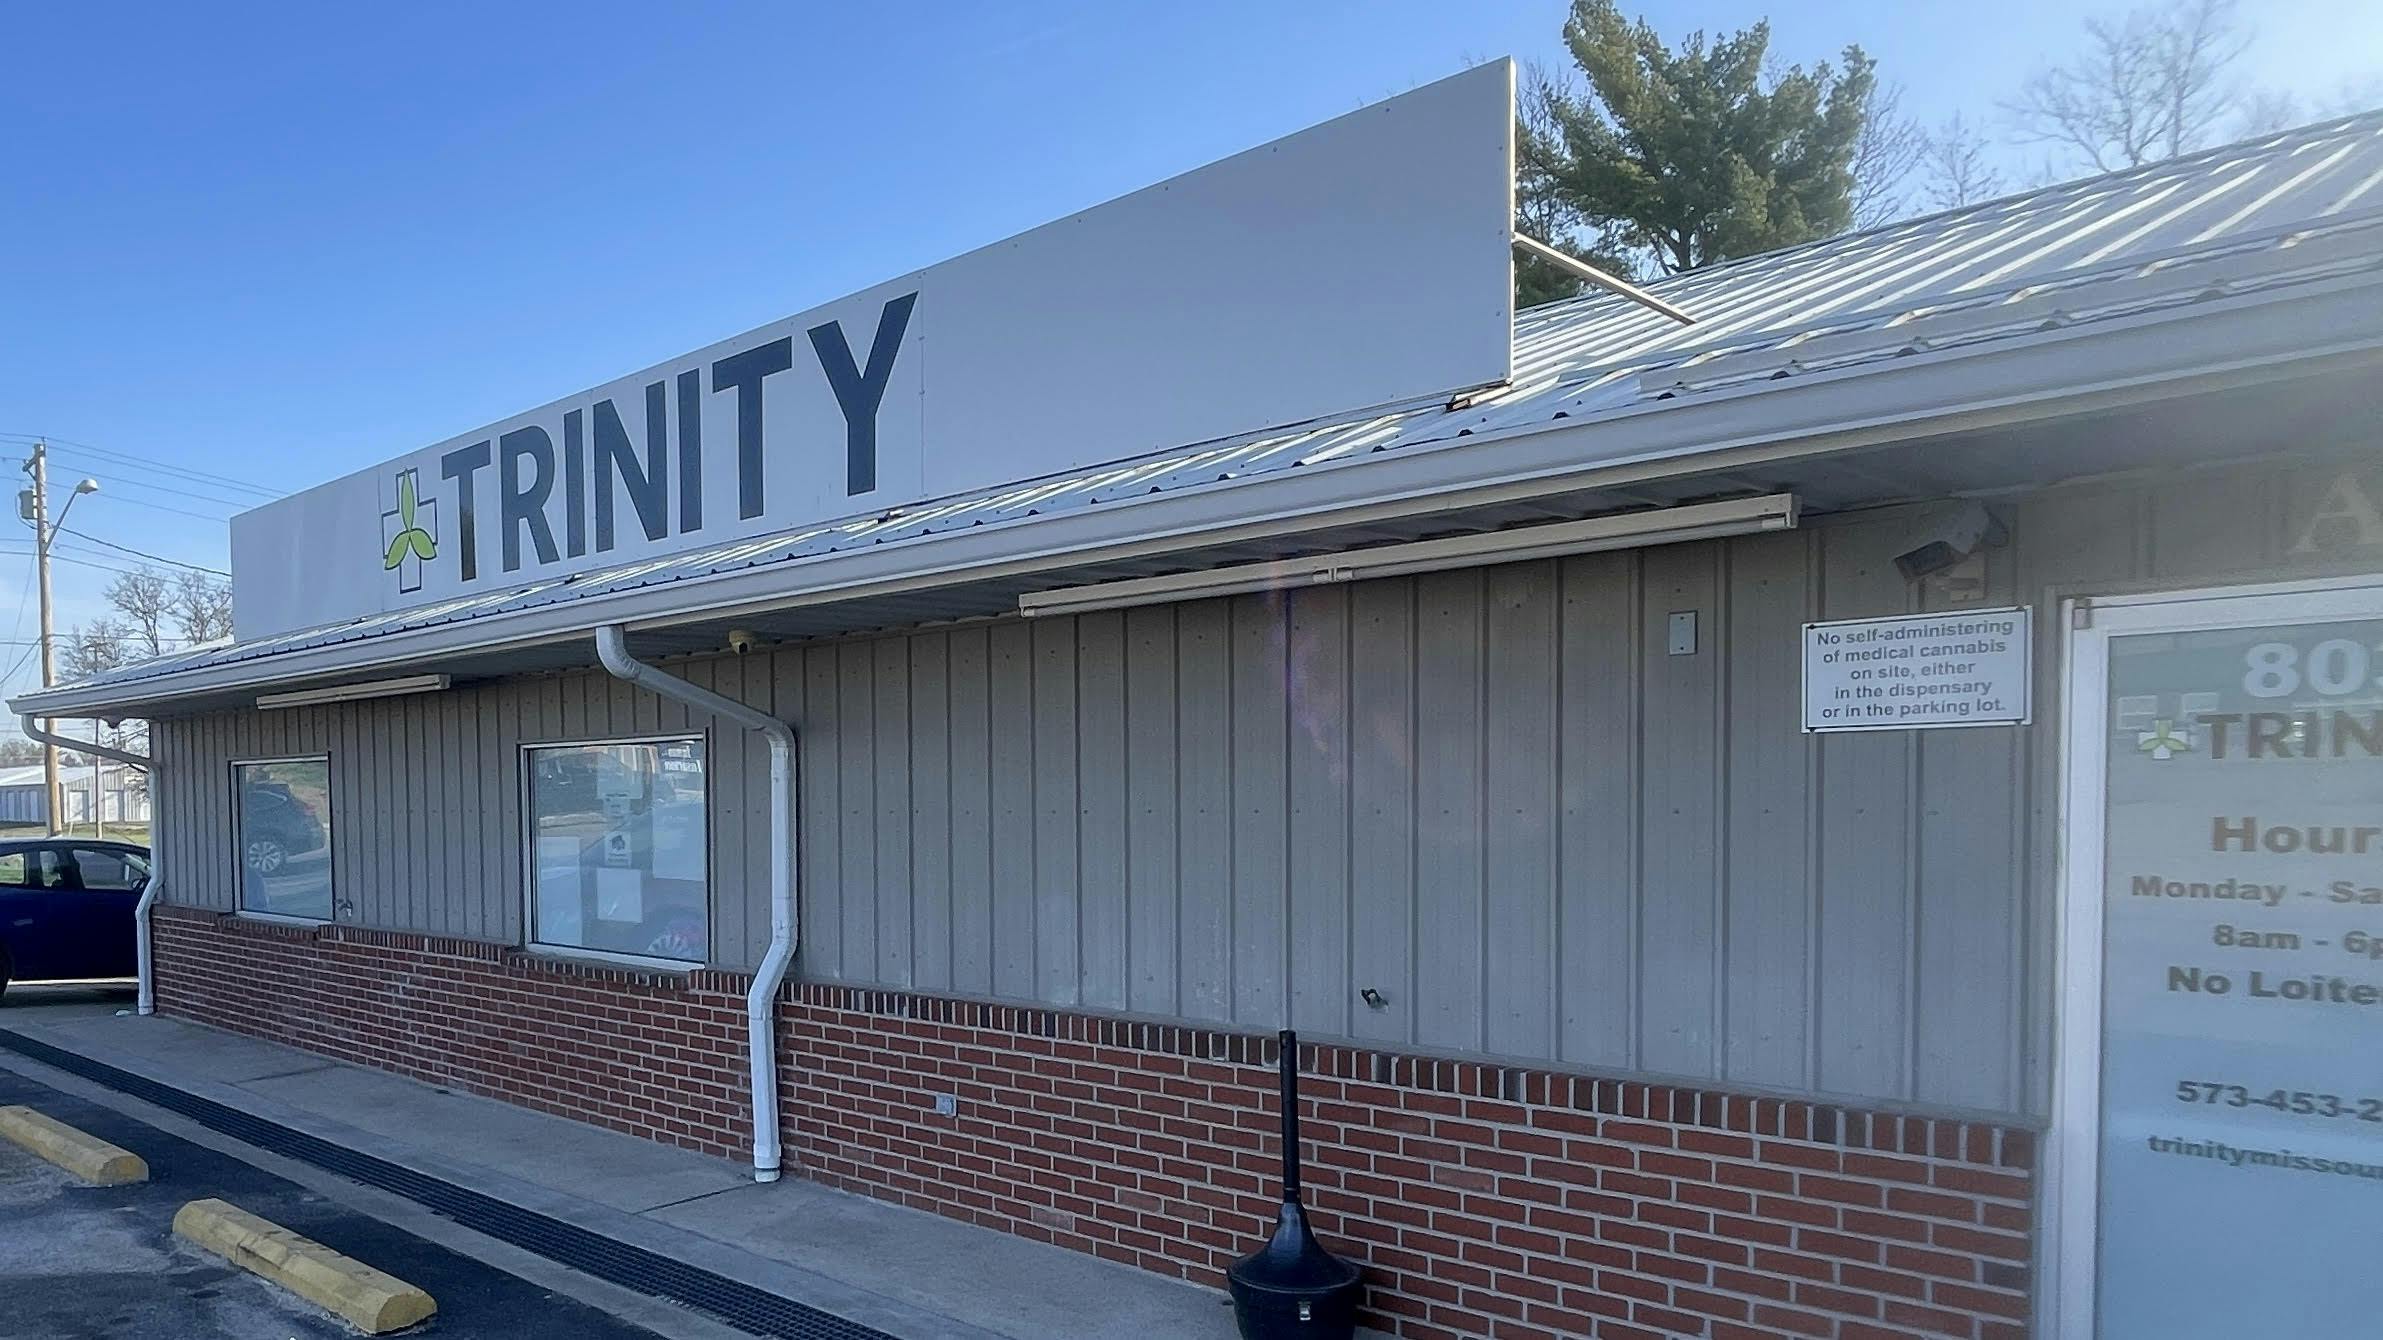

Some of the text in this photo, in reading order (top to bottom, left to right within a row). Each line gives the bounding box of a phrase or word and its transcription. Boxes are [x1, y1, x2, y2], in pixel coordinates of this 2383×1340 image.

[441, 291, 919, 582] TRINITY
[1817, 620, 2014, 646] No self-administering
[1823, 639, 2006, 663] of medical cannabis
[1851, 661, 1976, 680] on site, either
[2243, 639, 2383, 698] 80
[1835, 679, 1992, 699] in the dispensary
[1822, 697, 2006, 719] or in the parking lot.
[2195, 711, 2383, 759] TRIN
[2211, 816, 2383, 854] Hour
[2131, 875, 2287, 907] Monday
[2213, 924, 2301, 951] 8am
[2167, 966, 2383, 1005] No Loite
[2176, 1080, 2383, 1124] 573-453-2
